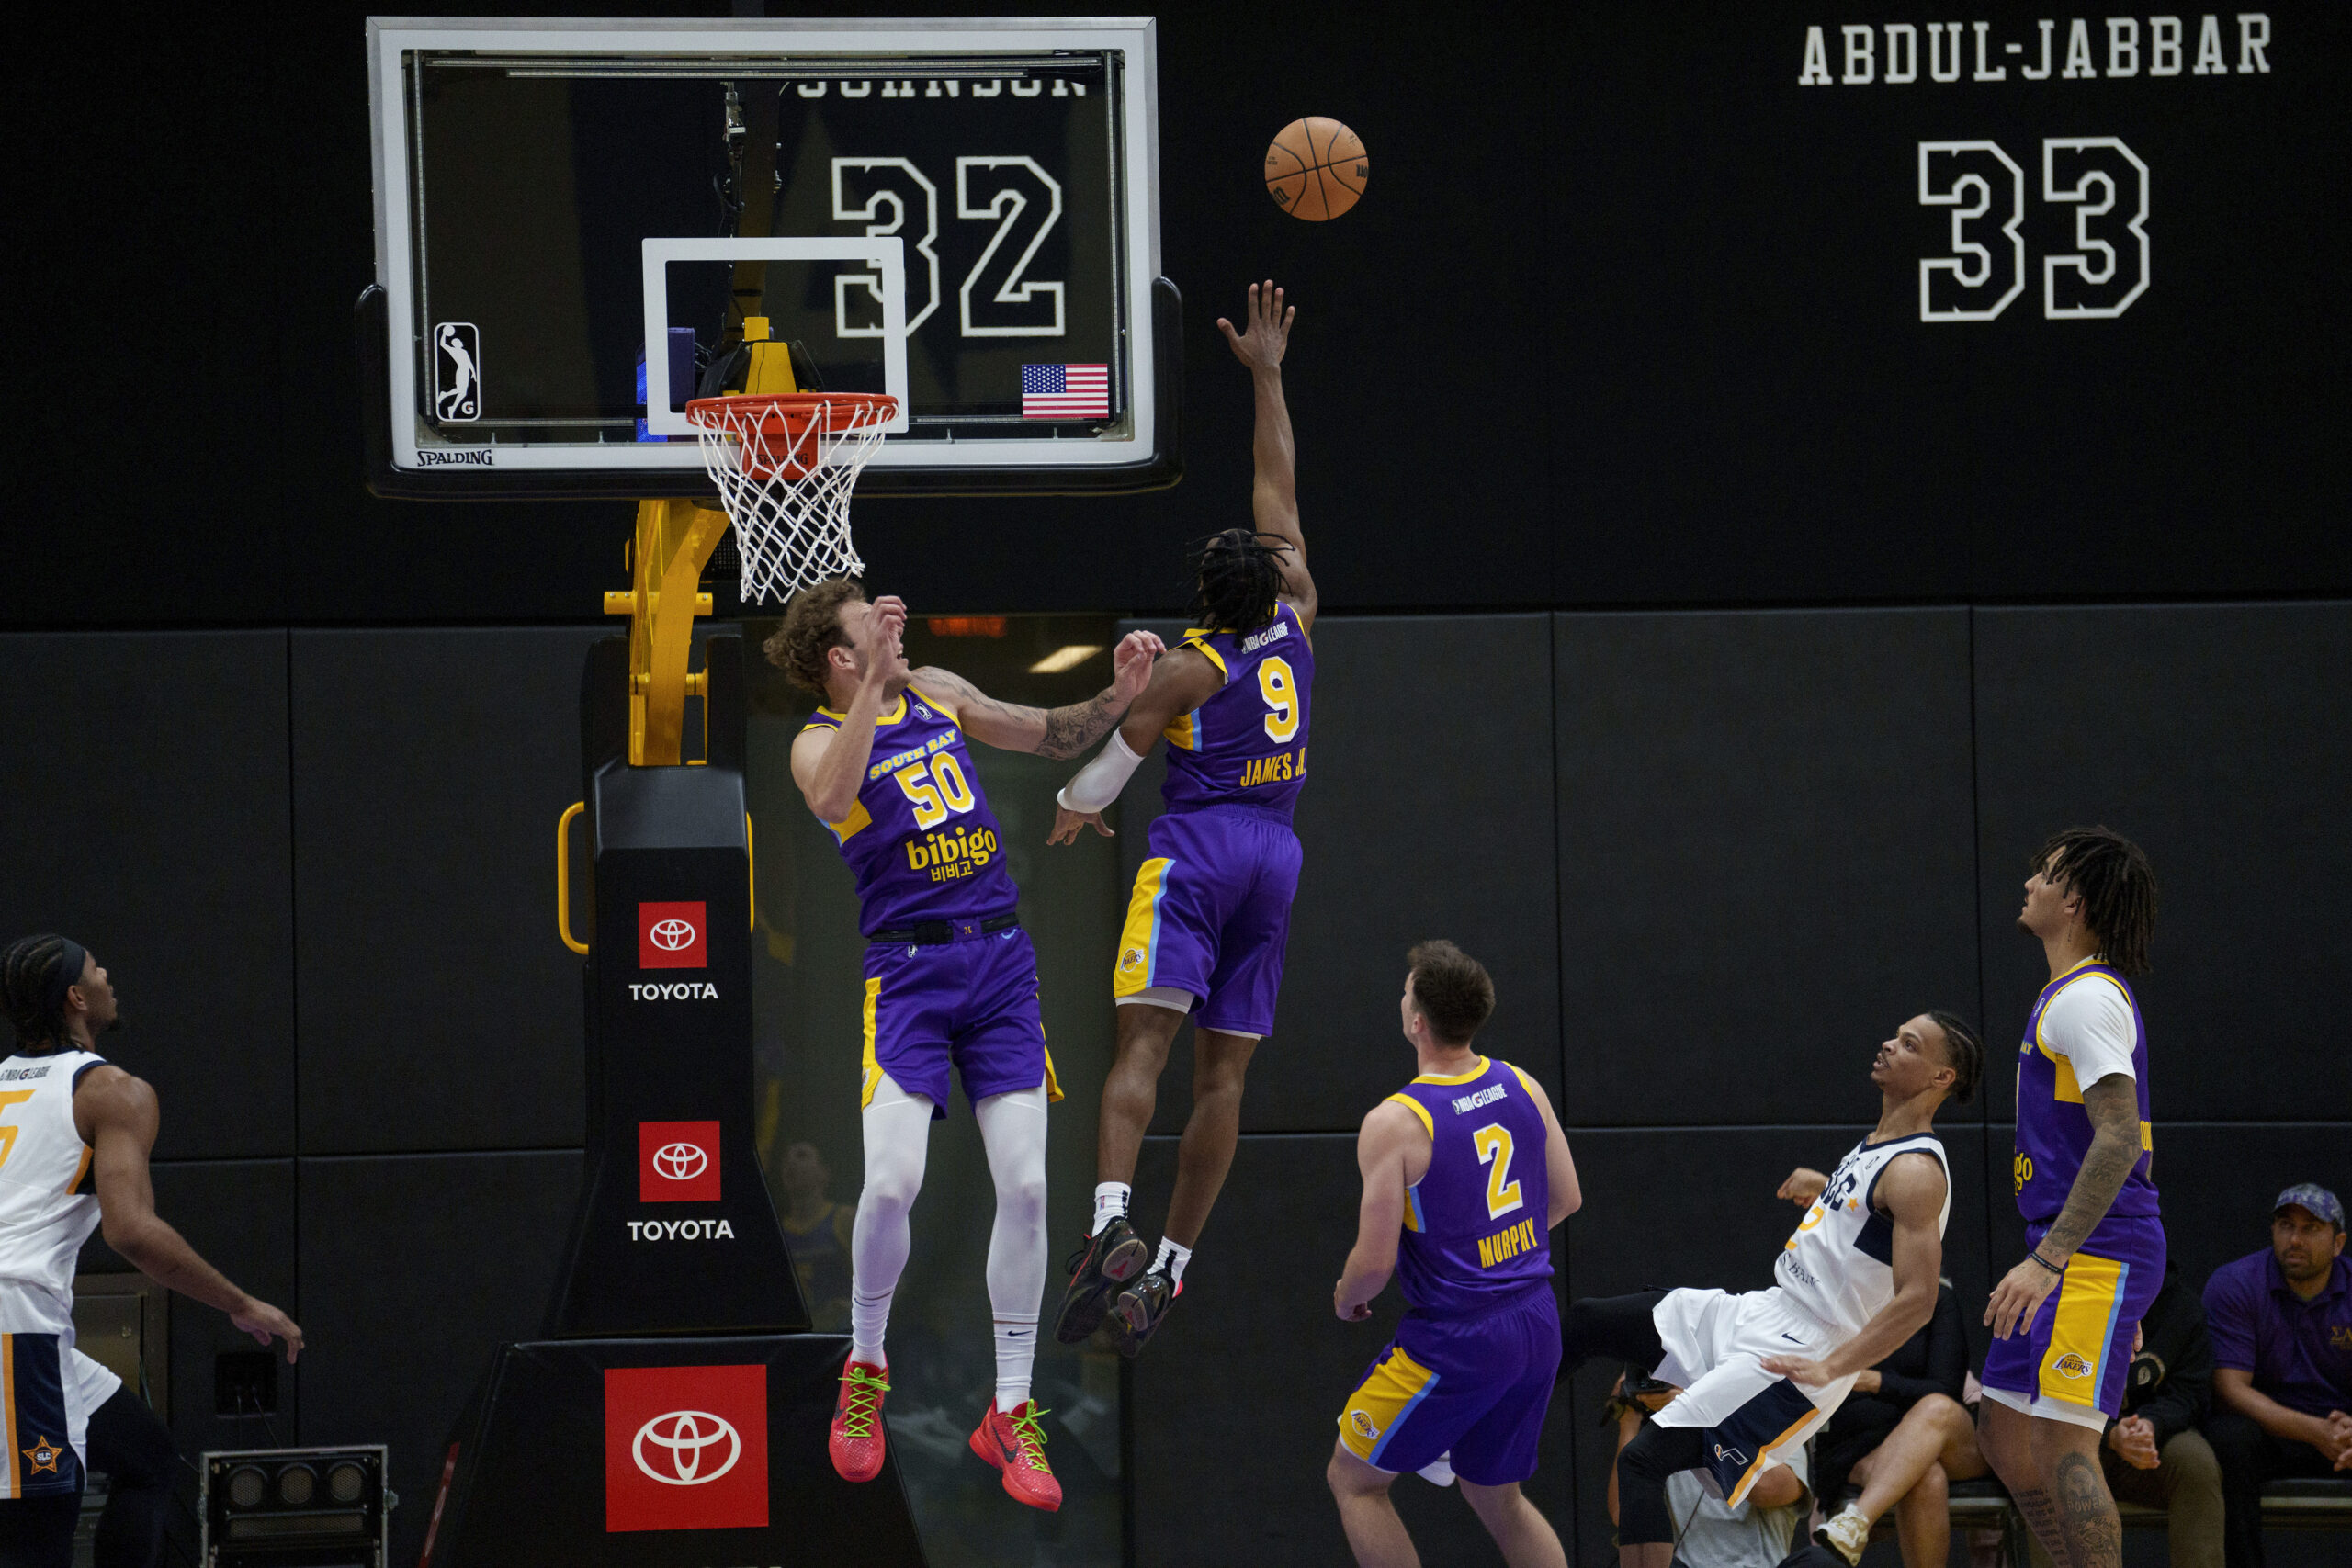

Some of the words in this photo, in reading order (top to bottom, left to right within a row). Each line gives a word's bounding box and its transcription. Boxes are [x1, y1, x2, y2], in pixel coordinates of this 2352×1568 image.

[1798, 13, 2271, 85] ABDUL-JABBAR
[831, 155, 1066, 339] 32
[1918, 137, 2150, 322] 33
[417, 449, 493, 467] SPALDING
[1257, 655, 1299, 744] 9
[869, 745, 927, 780] SOUTH
[926, 729, 957, 753] BAY
[1240, 752, 1292, 787] JAMES
[893, 750, 976, 831] 50
[905, 826, 998, 870] bibigo
[930, 860, 974, 882] 비비고
[628, 983, 718, 1001] TOYOTA
[1459, 1096, 1474, 1113] NBA
[1479, 1083, 1508, 1105] LEAGUE
[1473, 1122, 1523, 1221] 2
[627, 1220, 735, 1241] TOYOTA
[1477, 1216, 1538, 1269] MURPHY
[2055, 1358, 2091, 1376] LAKERS
[37, 1452, 51, 1461] SLC
